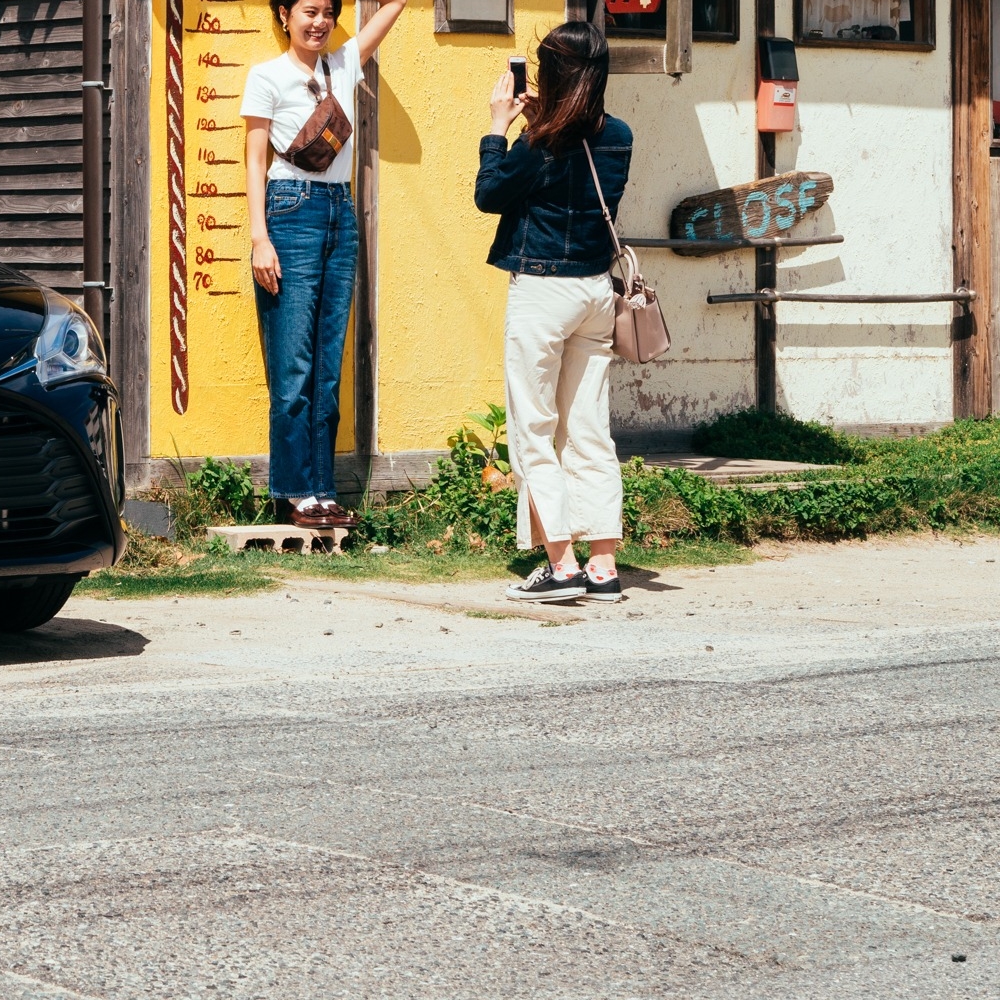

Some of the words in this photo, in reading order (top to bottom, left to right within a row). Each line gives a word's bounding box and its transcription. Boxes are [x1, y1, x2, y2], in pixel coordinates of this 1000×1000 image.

[197, 12, 221, 32] 150
[198, 51, 221, 68] 140
[196, 86, 217, 103] 130
[196, 118, 216, 131] 120
[198, 148, 216, 161] 110
[196, 182, 218, 195] 100
[196, 213, 217, 233] 90
[195, 246, 215, 265] 80
[193, 271, 213, 291] 70
